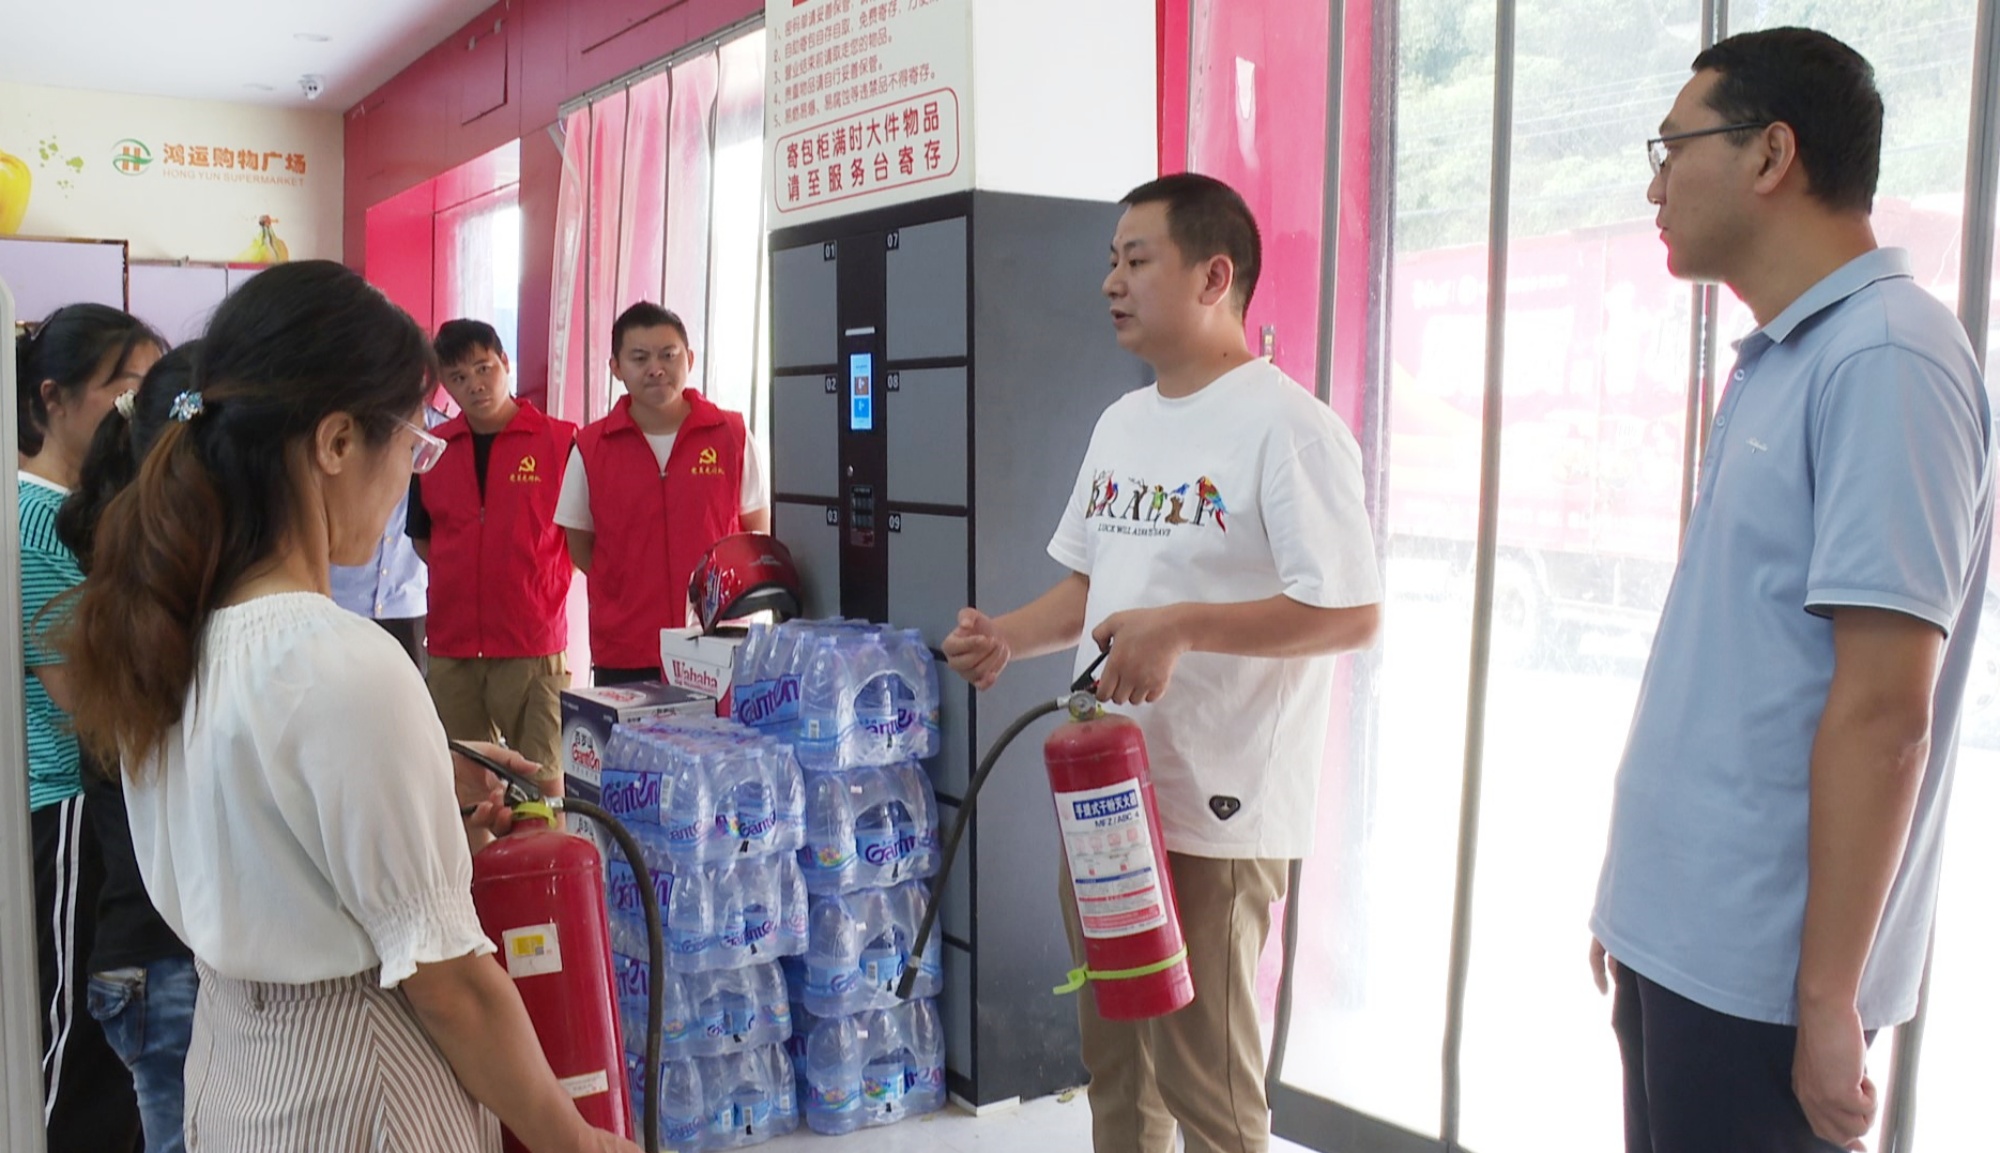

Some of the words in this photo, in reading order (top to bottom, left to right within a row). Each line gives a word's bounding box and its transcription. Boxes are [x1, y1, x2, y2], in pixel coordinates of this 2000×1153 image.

[786, 101, 940, 169] 寄包柜满时大件物品
[163, 143, 306, 175] 鸿运购物广场
[163, 168, 196, 180] HONG
[199, 172, 221, 182] YUN
[223, 173, 305, 187] SUPERMARKET
[787, 139, 941, 203] 请至服务台寄存
[887, 233, 899, 248] 07
[825, 243, 835, 259] 01
[826, 377, 837, 392] 02
[887, 374, 899, 390] 08
[827, 509, 838, 524] 03
[888, 514, 900, 530] 09
[672, 659, 718, 687] Wahaha
